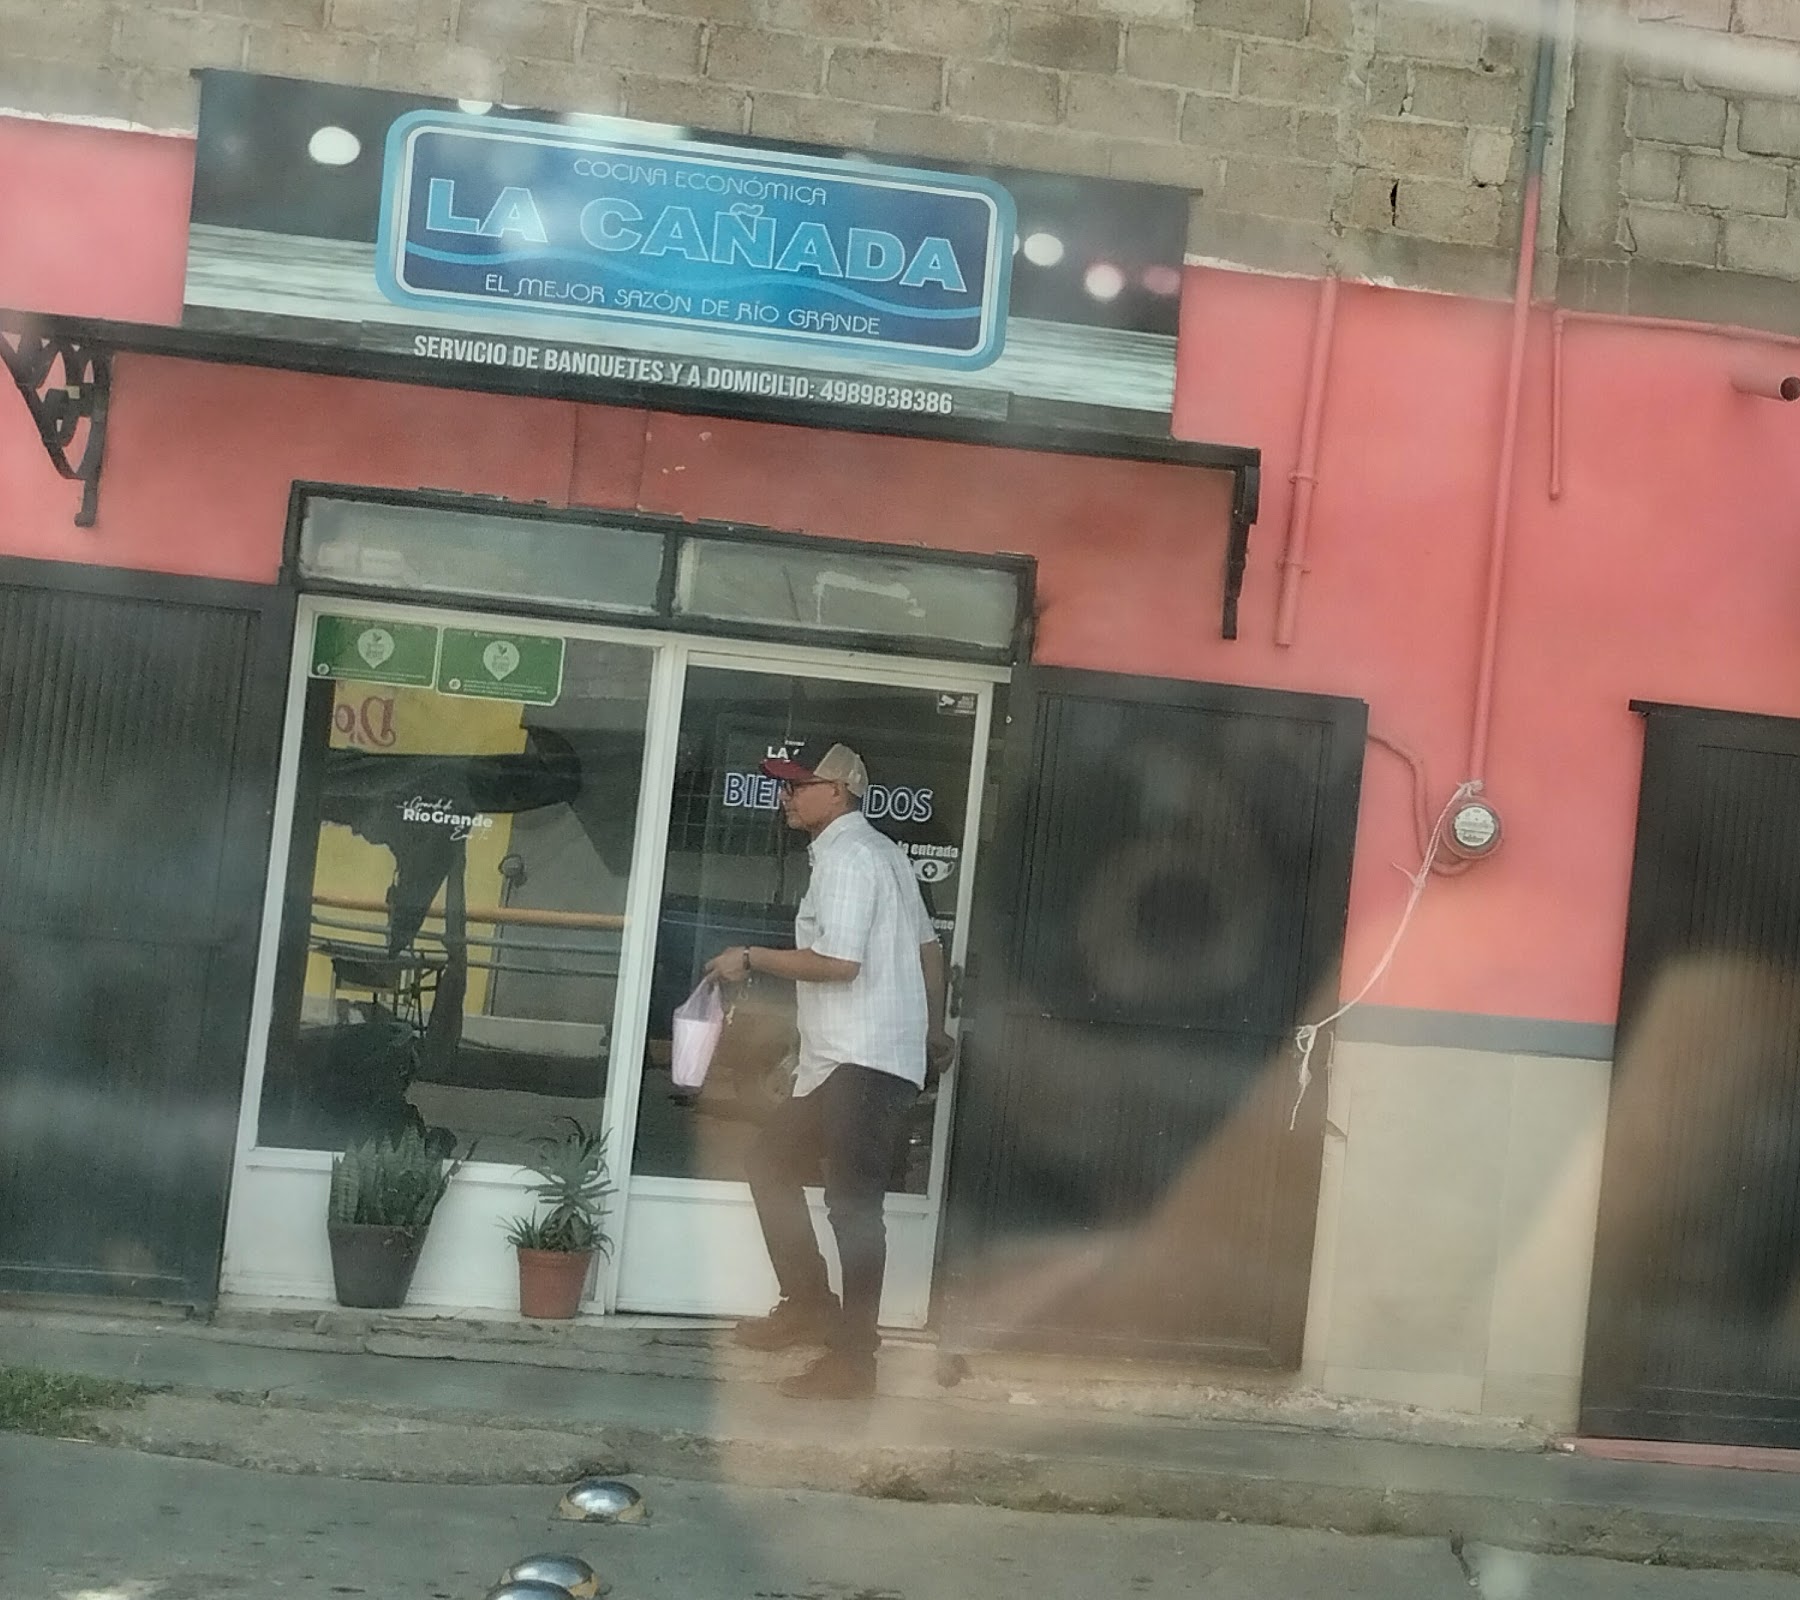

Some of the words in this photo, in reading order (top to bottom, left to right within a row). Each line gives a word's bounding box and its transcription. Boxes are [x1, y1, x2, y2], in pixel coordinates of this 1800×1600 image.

[573, 157, 668, 187] COCINA
[674, 171, 827, 205] ECONÓMICA
[425, 177, 548, 243] LA
[579, 197, 968, 293] CAÑADA
[485, 273, 509, 293] EL
[513, 277, 605, 304] MEJOR
[613, 288, 692, 314] SAZÓN
[701, 298, 730, 318] DE
[734, 299, 780, 323] RÍO
[788, 308, 881, 335] GRANDE
[413, 334, 507, 365] SERVICIO
[512, 345, 540, 370] DE
[544, 348, 665, 384] BANQUETES
[669, 363, 686, 385] Y
[686, 364, 701, 387] A
[706, 366, 815, 400] DOMICILIO:
[820, 379, 953, 415] 4989838386
